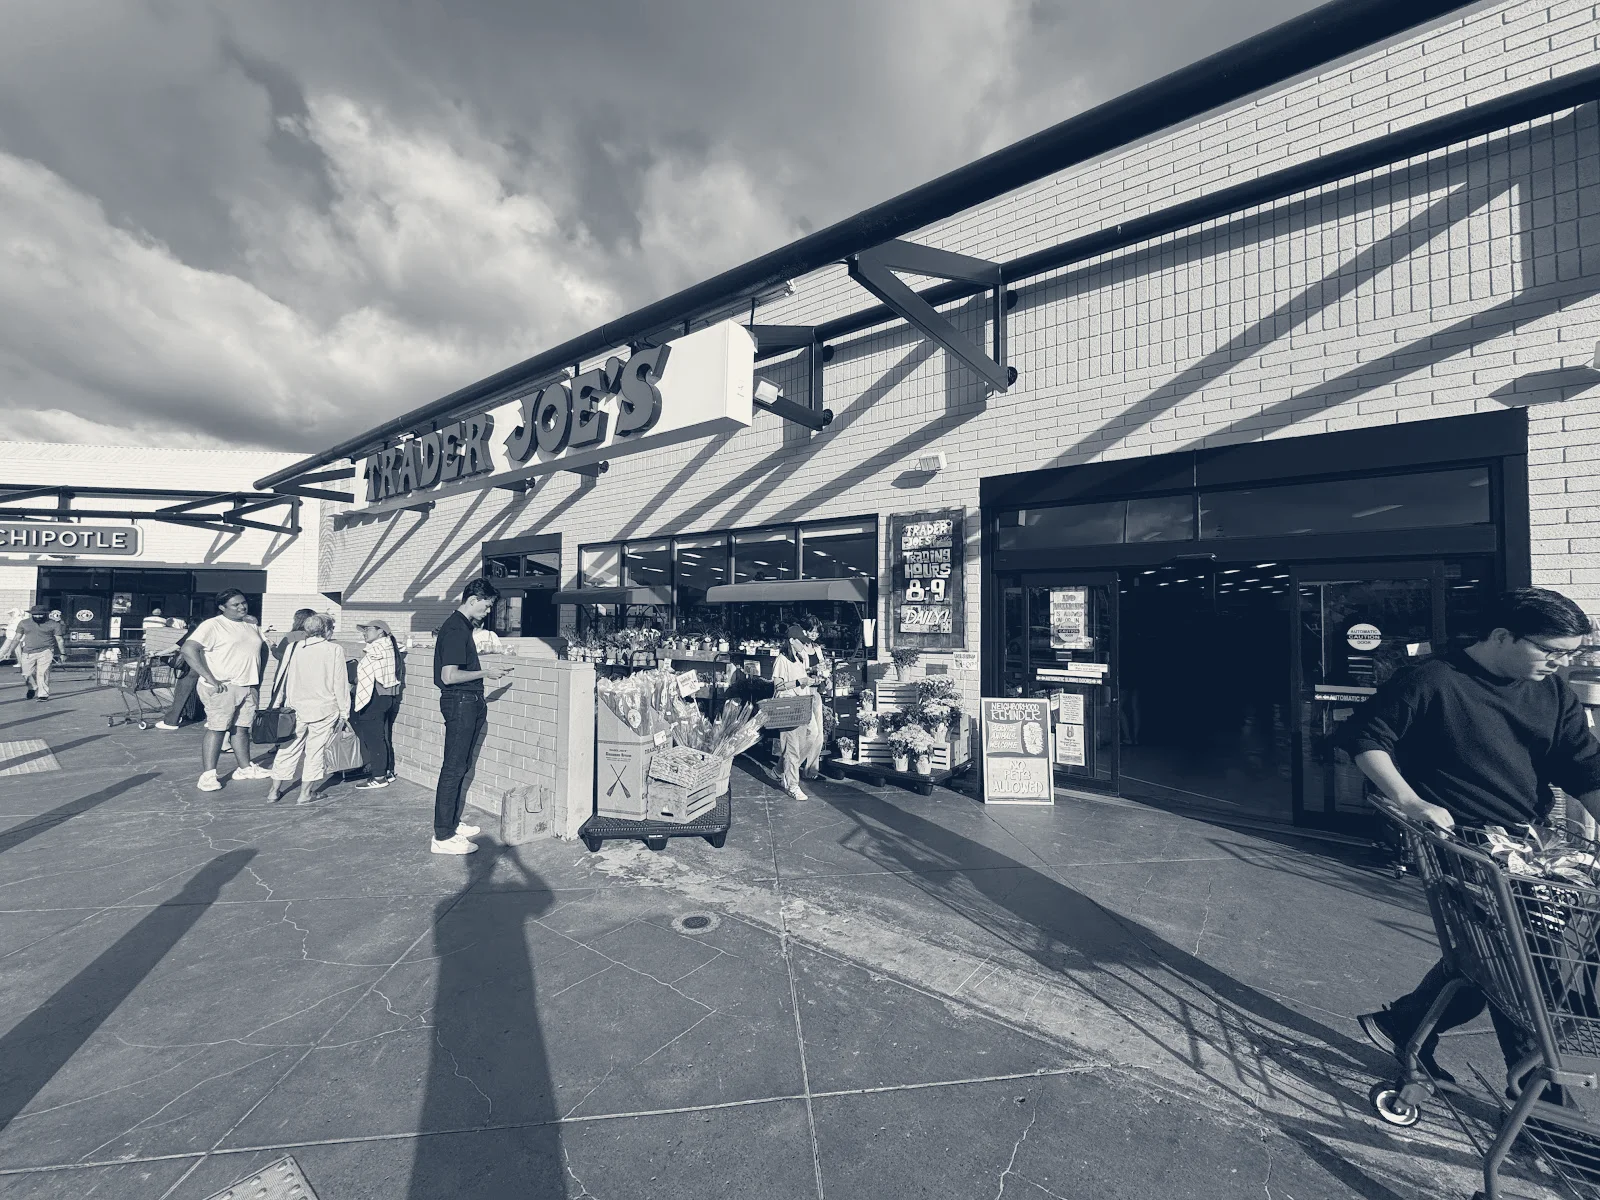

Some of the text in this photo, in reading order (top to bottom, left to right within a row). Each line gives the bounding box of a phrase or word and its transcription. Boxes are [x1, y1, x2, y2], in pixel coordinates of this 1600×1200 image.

[364, 342, 672, 501] TRADER JOE'S
[905, 523, 948, 537] TRADER
[904, 563, 951, 579] HOURS
[905, 608, 950, 626] DAILY!
[991, 702, 1040, 710] NEIGHBORHOOD
[990, 709, 1042, 720] REMINDER
[1010, 760, 1027, 770] NO
[1005, 769, 1032, 781] PETS
[992, 780, 1044, 793] ALLOWED
